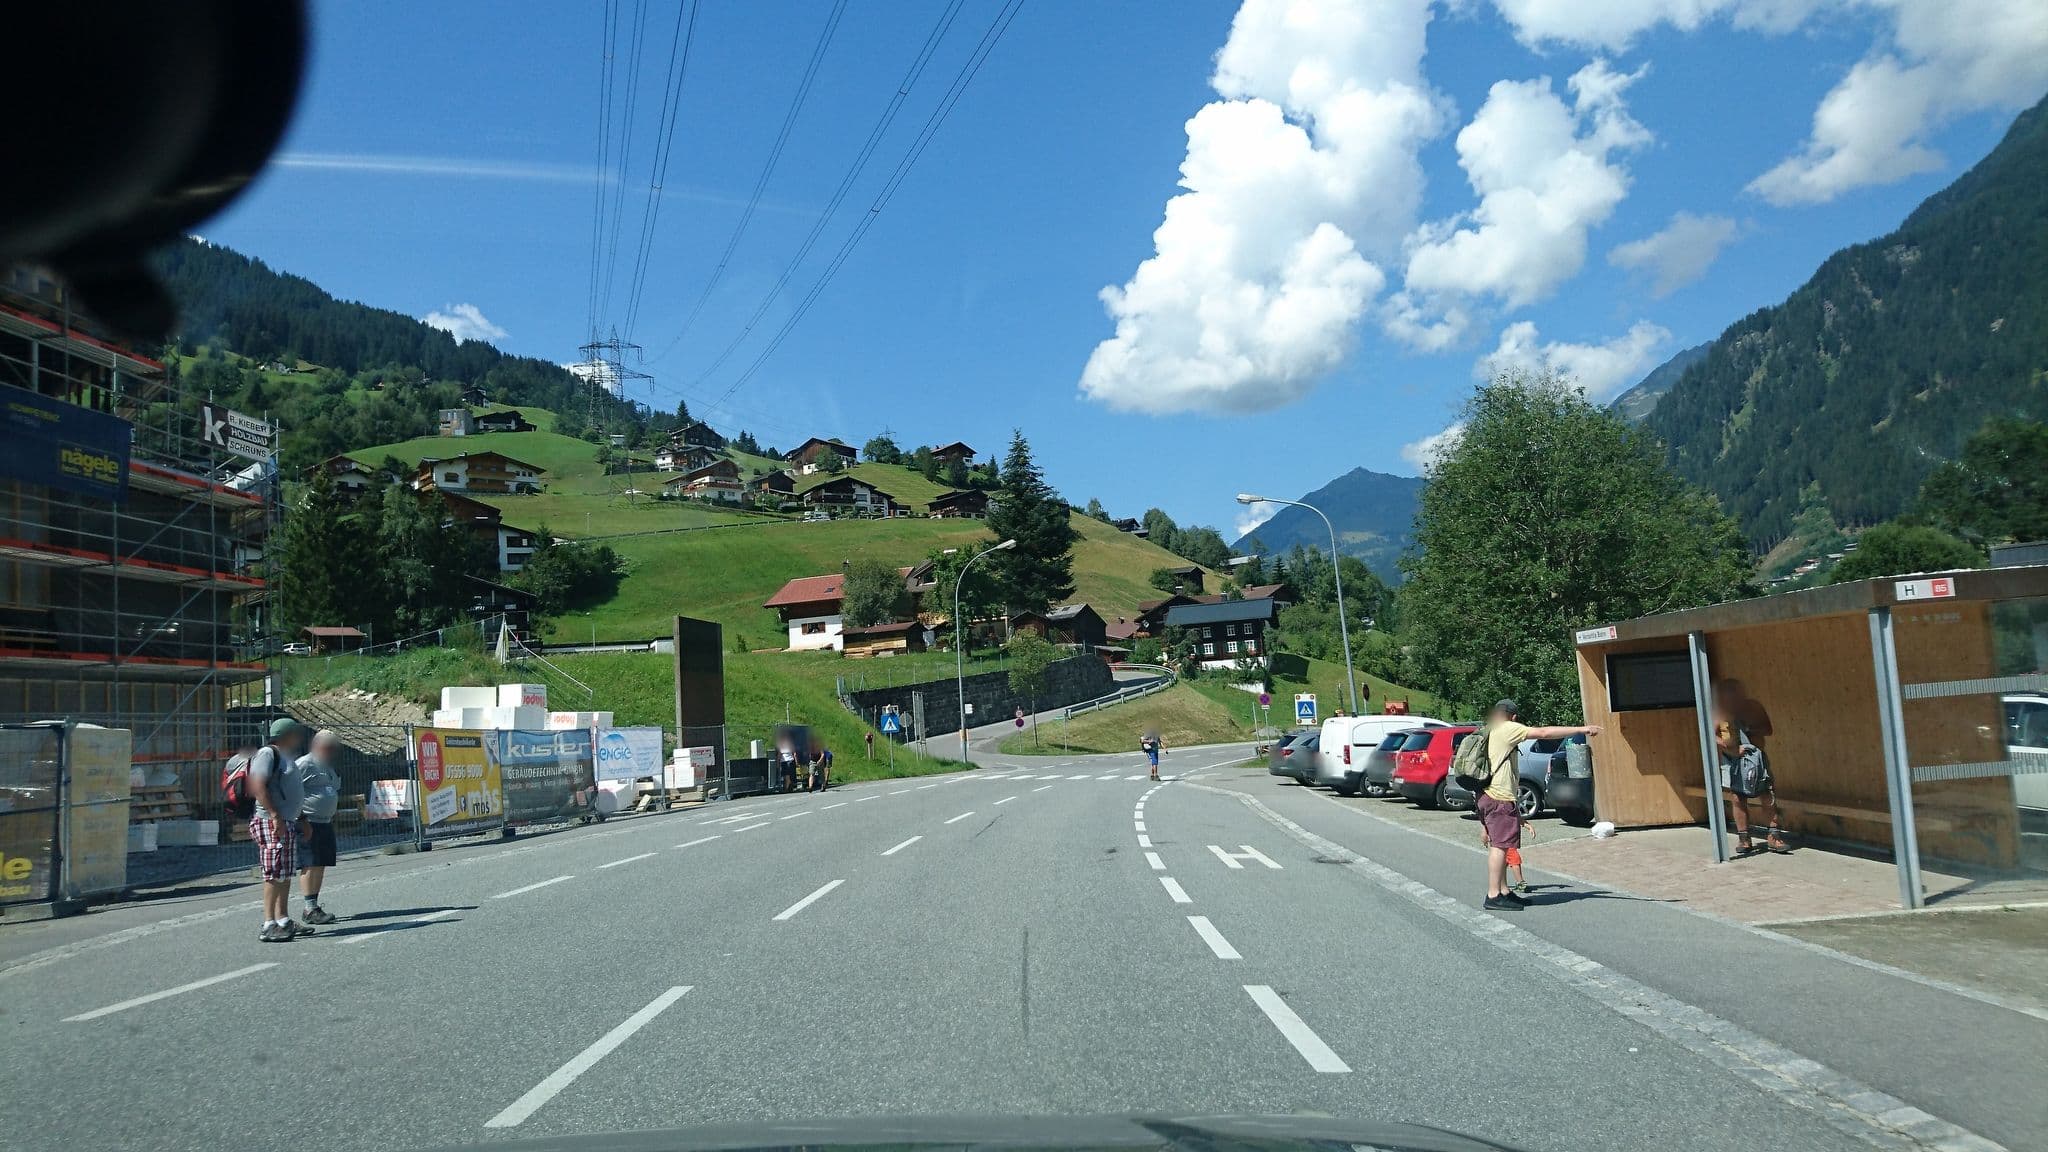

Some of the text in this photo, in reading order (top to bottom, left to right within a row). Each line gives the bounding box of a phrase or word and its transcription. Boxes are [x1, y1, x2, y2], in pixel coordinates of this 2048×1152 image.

[239, 418, 267, 433] KIEBER
[231, 427, 268, 446] HOLZBAU
[229, 440, 267, 458] SCHRUNS
[61, 447, 120, 474] nägele
[1904, 584, 1916, 596] H
[421, 741, 438, 757] WIR
